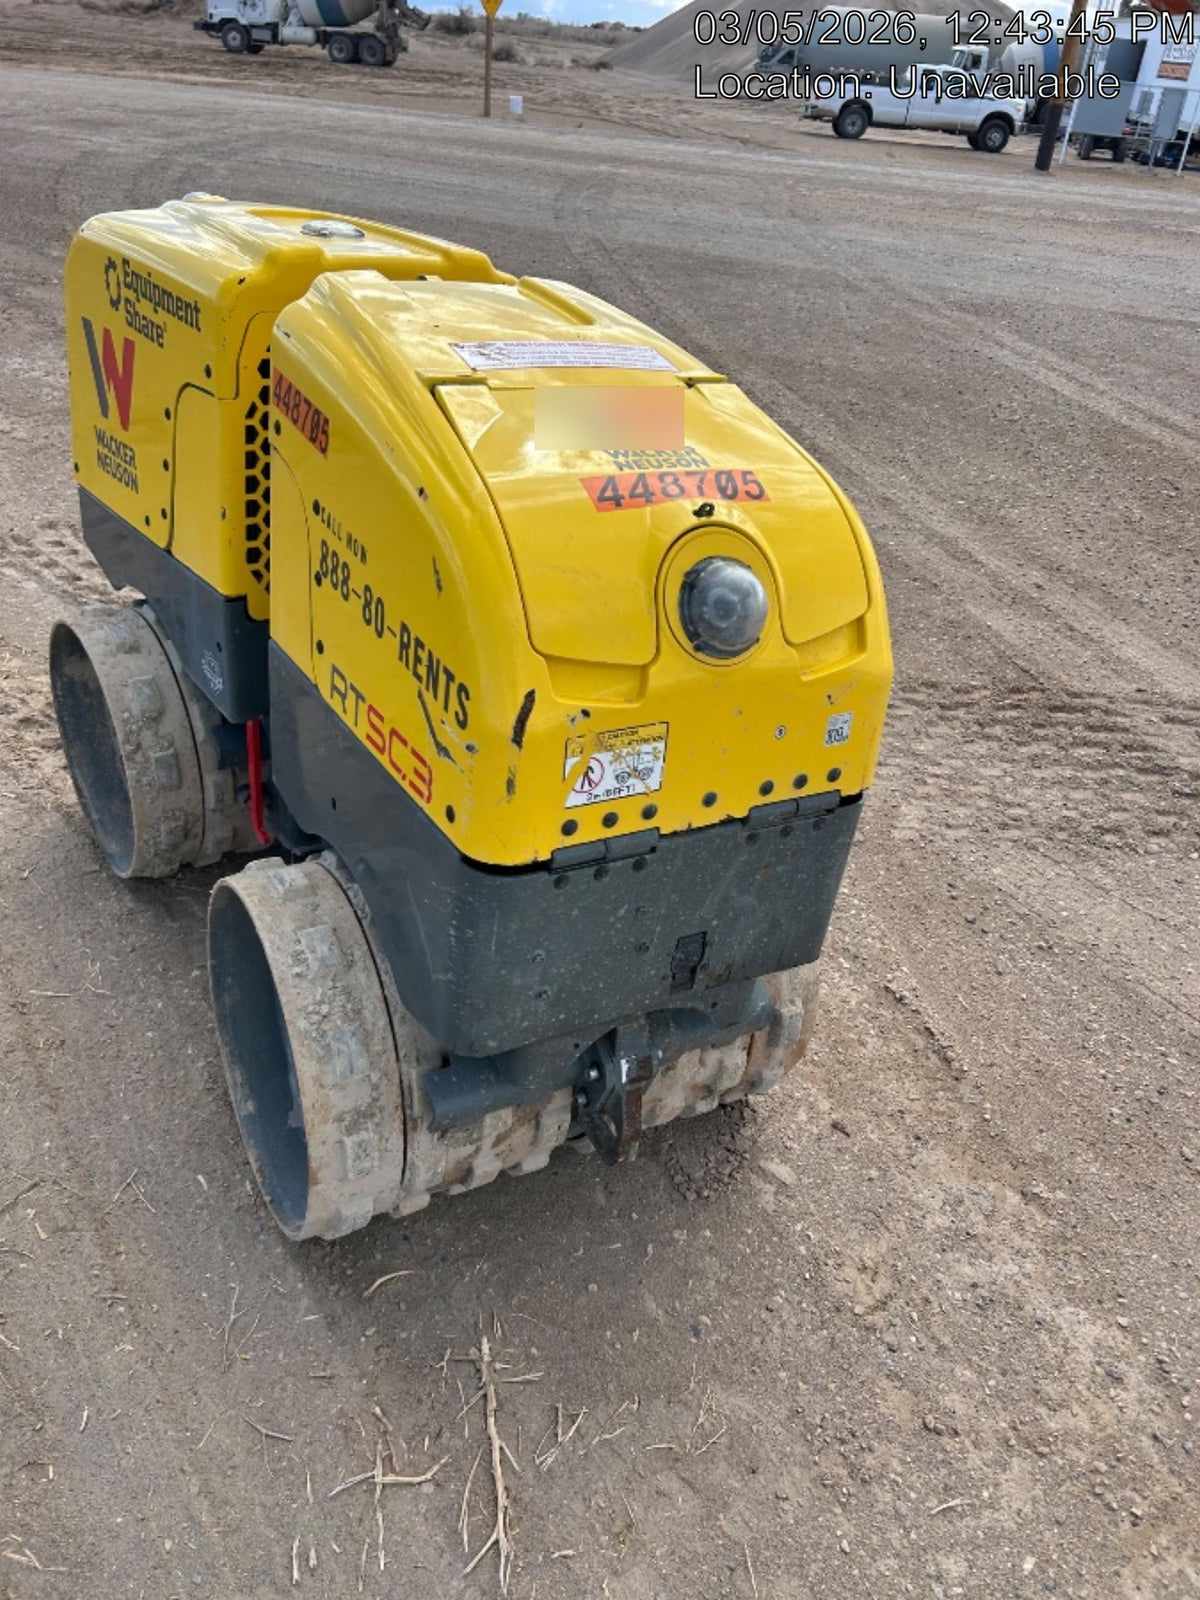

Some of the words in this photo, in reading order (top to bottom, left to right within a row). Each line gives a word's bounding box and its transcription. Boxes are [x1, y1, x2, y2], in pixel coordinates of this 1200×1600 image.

[122, 257, 201, 332] Equipment
[273, 372, 329, 455] 448705
[94, 424, 137, 471] WACKER
[613, 457, 710, 471] NEUSON
[97, 448, 139, 495] NEUSON
[597, 470, 766, 508] 448705
[321, 506, 342, 541] CALL
[320, 538, 471, 731] 888-80-RENTS
